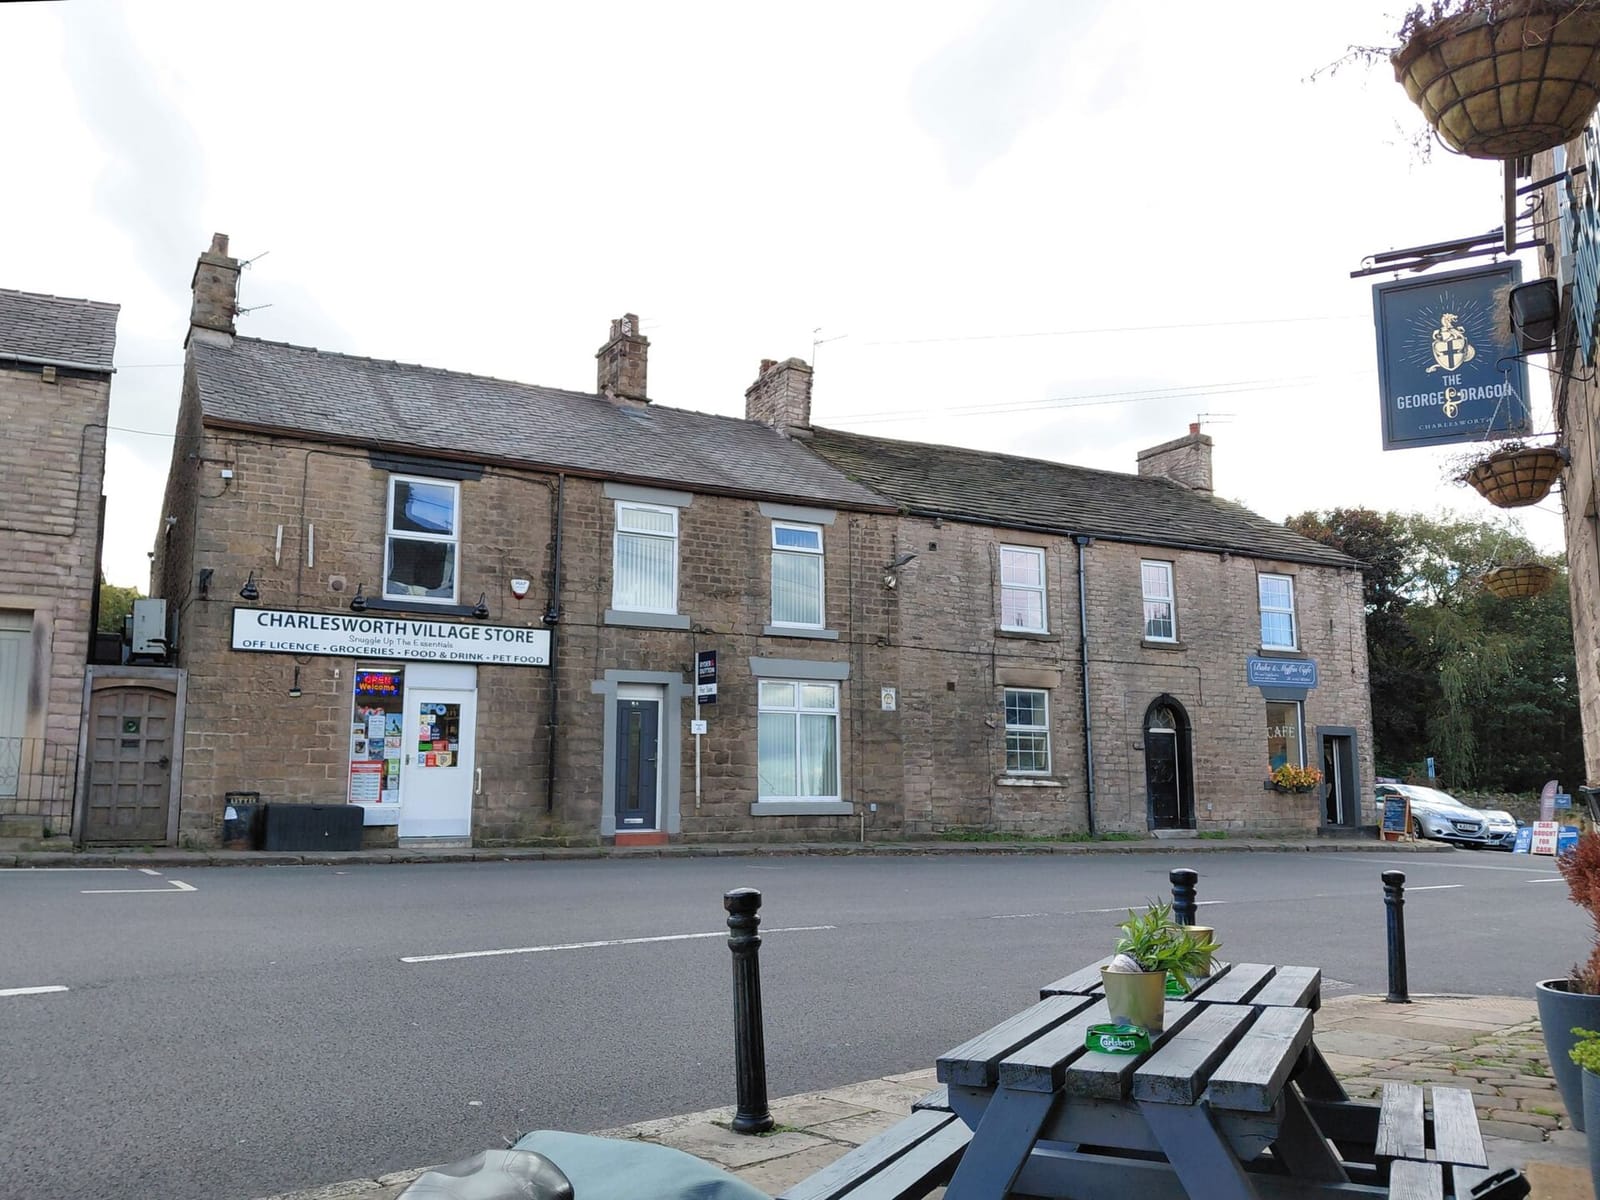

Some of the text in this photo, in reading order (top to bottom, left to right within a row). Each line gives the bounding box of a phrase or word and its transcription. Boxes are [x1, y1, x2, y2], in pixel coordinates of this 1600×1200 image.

[1442, 374, 1462, 386] THE
[1397, 391, 1445, 410] GEORGE
[1460, 383, 1512, 401] DRAGON
[1418, 417, 1494, 431] CHARLESWORTH
[257, 612, 534, 643] CHARLESWORTH VILLAGE STORE
[349, 635, 453, 649] Snuggle Up The Essentials
[242, 640, 266, 648] OFF
[270, 641, 320, 651] LICENCE
[330, 645, 394, 655] GROCERIES
[404, 650, 437, 658] FOOD
[450, 652, 483, 660] DRINK
[493, 654, 511, 662] PET
[514, 656, 544, 664] FOOD
[359, 682, 395, 691] Welcome
[364, 675, 392, 684] OPEN
[1100, 1034, 1136, 1051] Carlsberg
